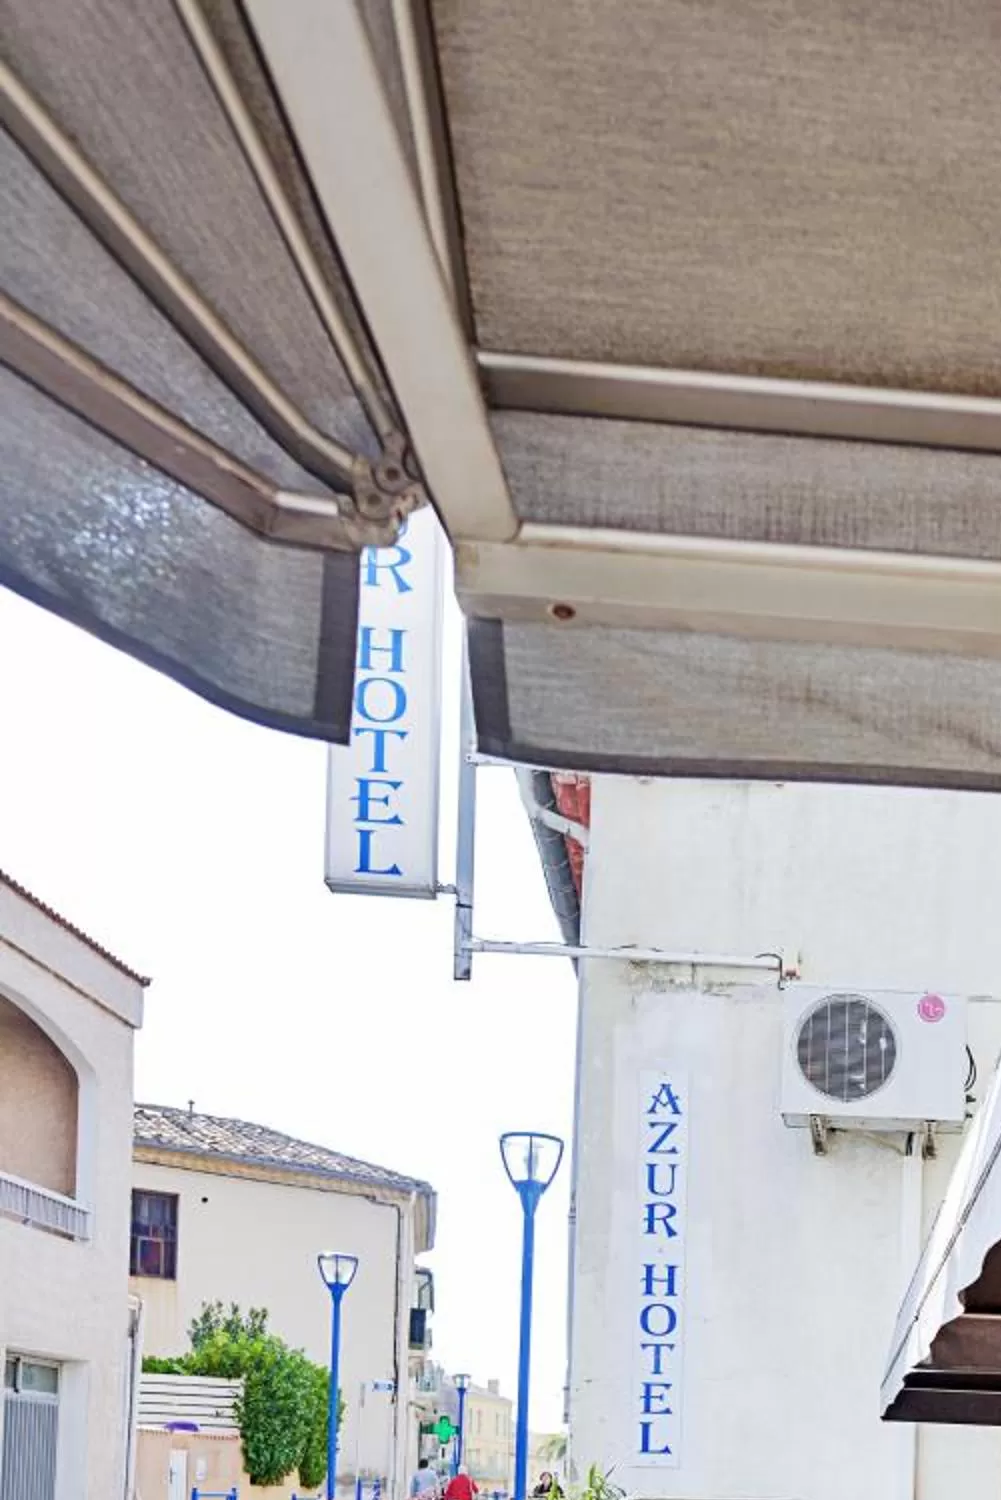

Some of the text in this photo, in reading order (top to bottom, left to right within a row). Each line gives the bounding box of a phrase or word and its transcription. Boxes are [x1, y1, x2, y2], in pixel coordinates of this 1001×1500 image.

[351, 626, 409, 876] HOTEL
[638, 1083, 682, 1455] AZUR HOTEL
